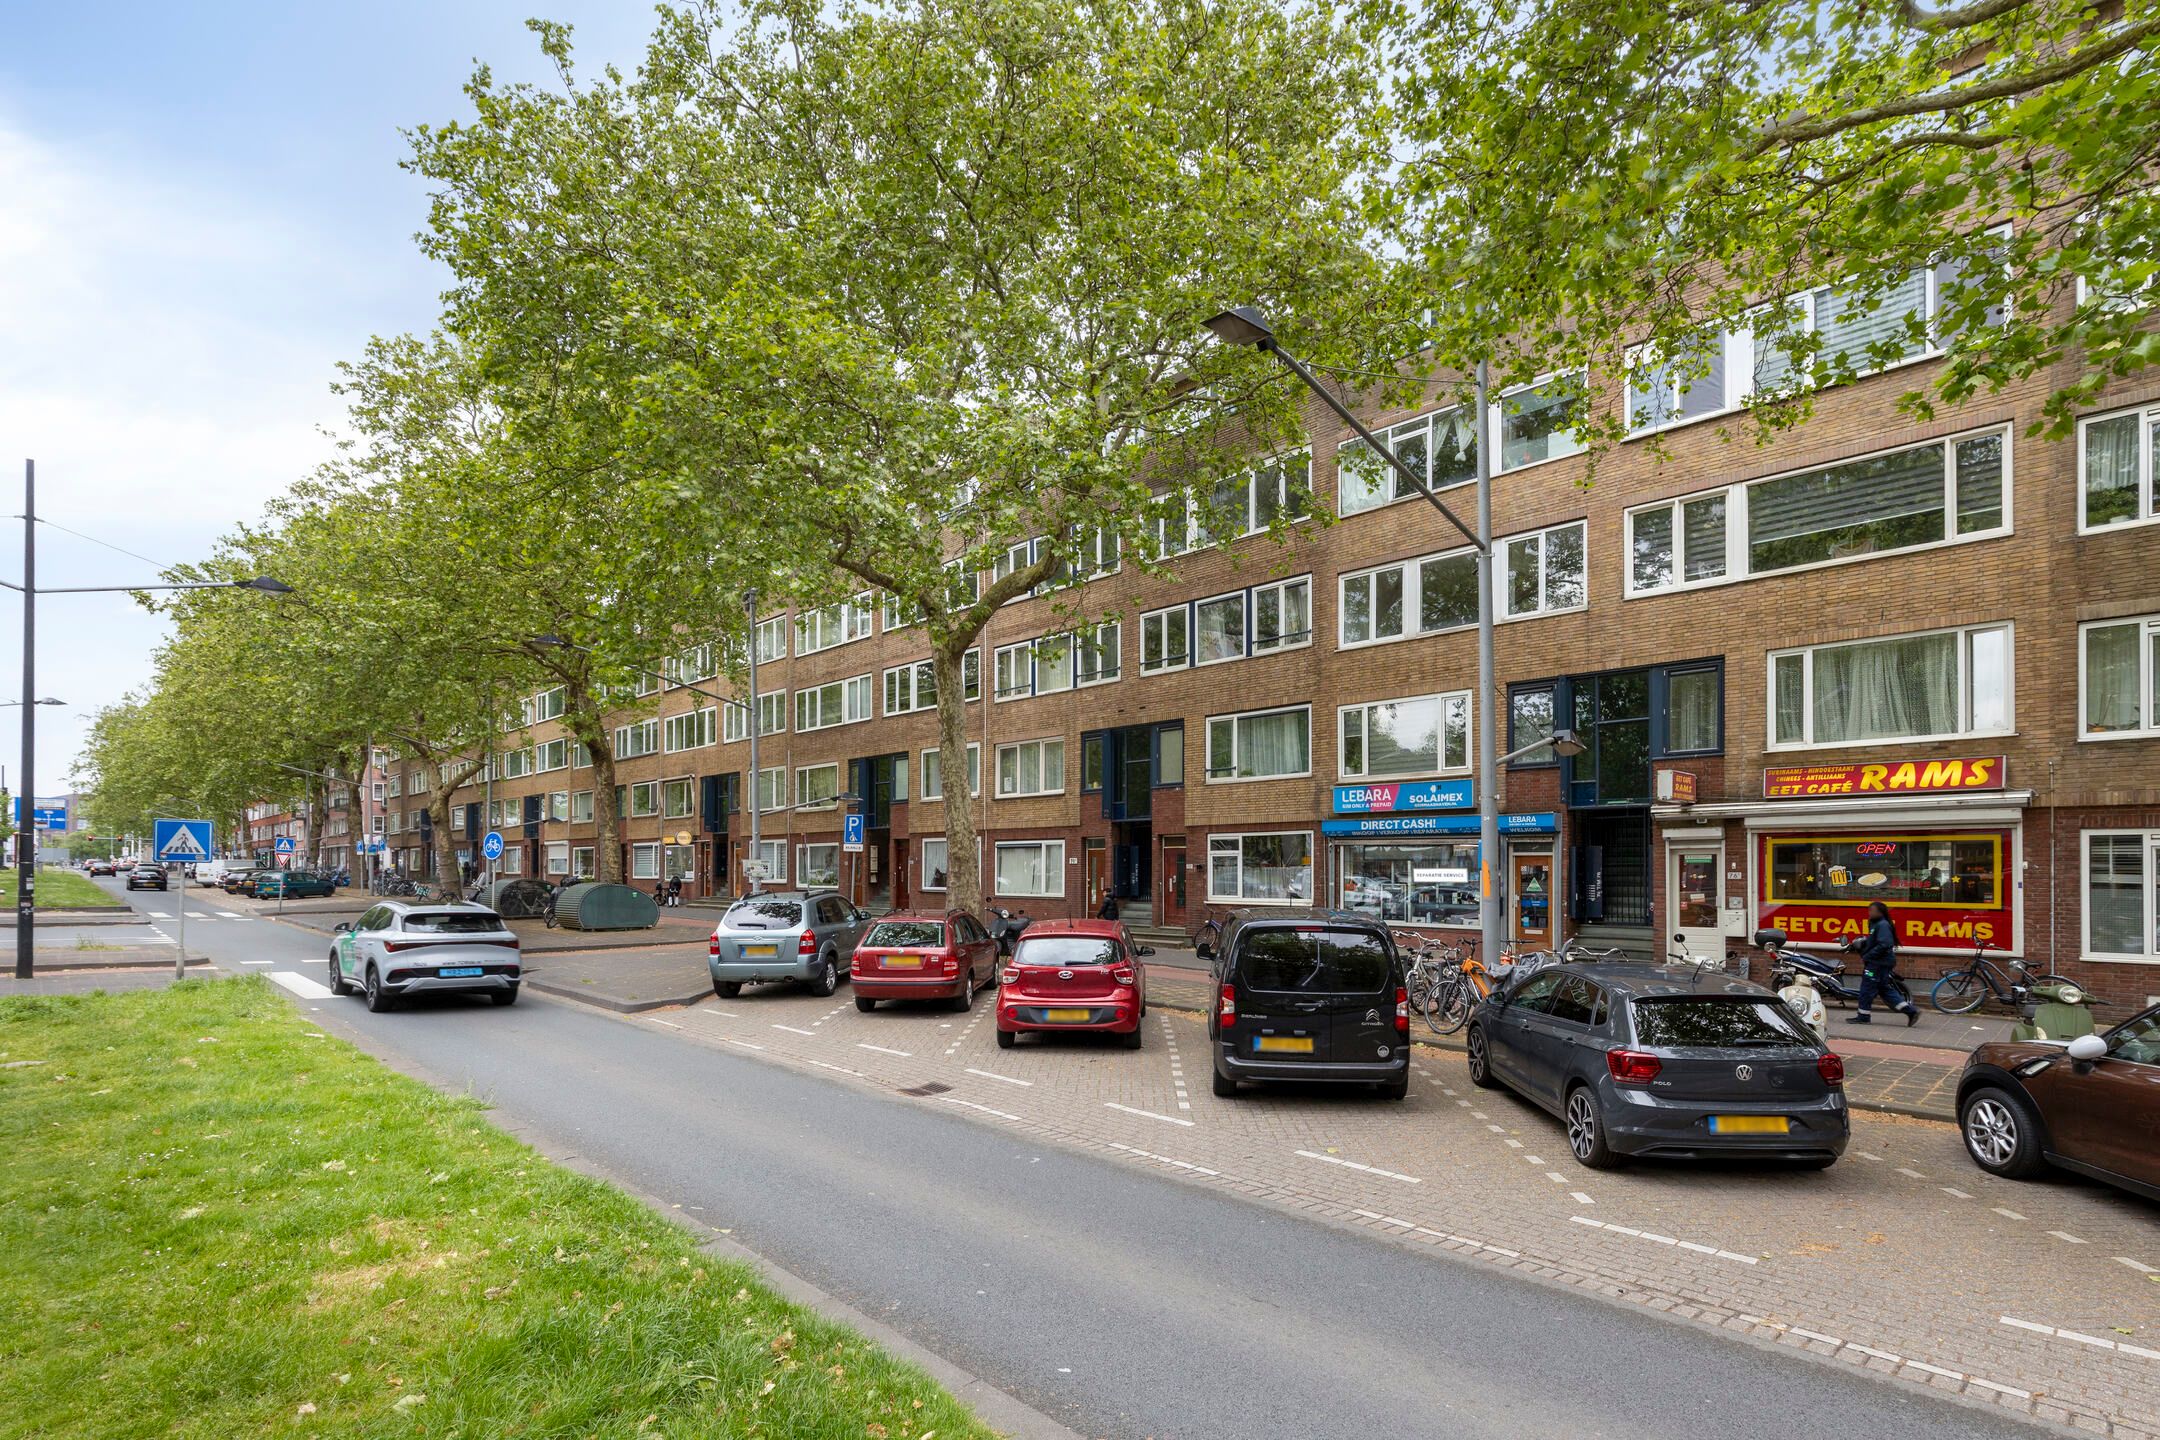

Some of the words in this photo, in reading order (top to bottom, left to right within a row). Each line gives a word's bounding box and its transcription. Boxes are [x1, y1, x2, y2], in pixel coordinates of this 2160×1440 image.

[1808, 766, 1855, 774] HINDOESTAANS
[1769, 785, 1802, 795] EET
[1807, 780, 1853, 794] CAFÉ
[1859, 758, 1995, 791] RAMS
[1806, 773, 1846, 781] ANTILLIAANS
[1342, 788, 1391, 802] LEBARA
[1409, 793, 1463, 804] SOLAIMEX
[849, 817, 859, 831] P
[1361, 819, 1400, 830] DIRECT
[1401, 818, 1436, 829] CASH!
[1508, 815, 1536, 823] LEBARA
[1856, 844, 1896, 854] OPEN
[1773, 917, 1895, 935] EETCAF
[1906, 920, 1994, 939] RAMS
